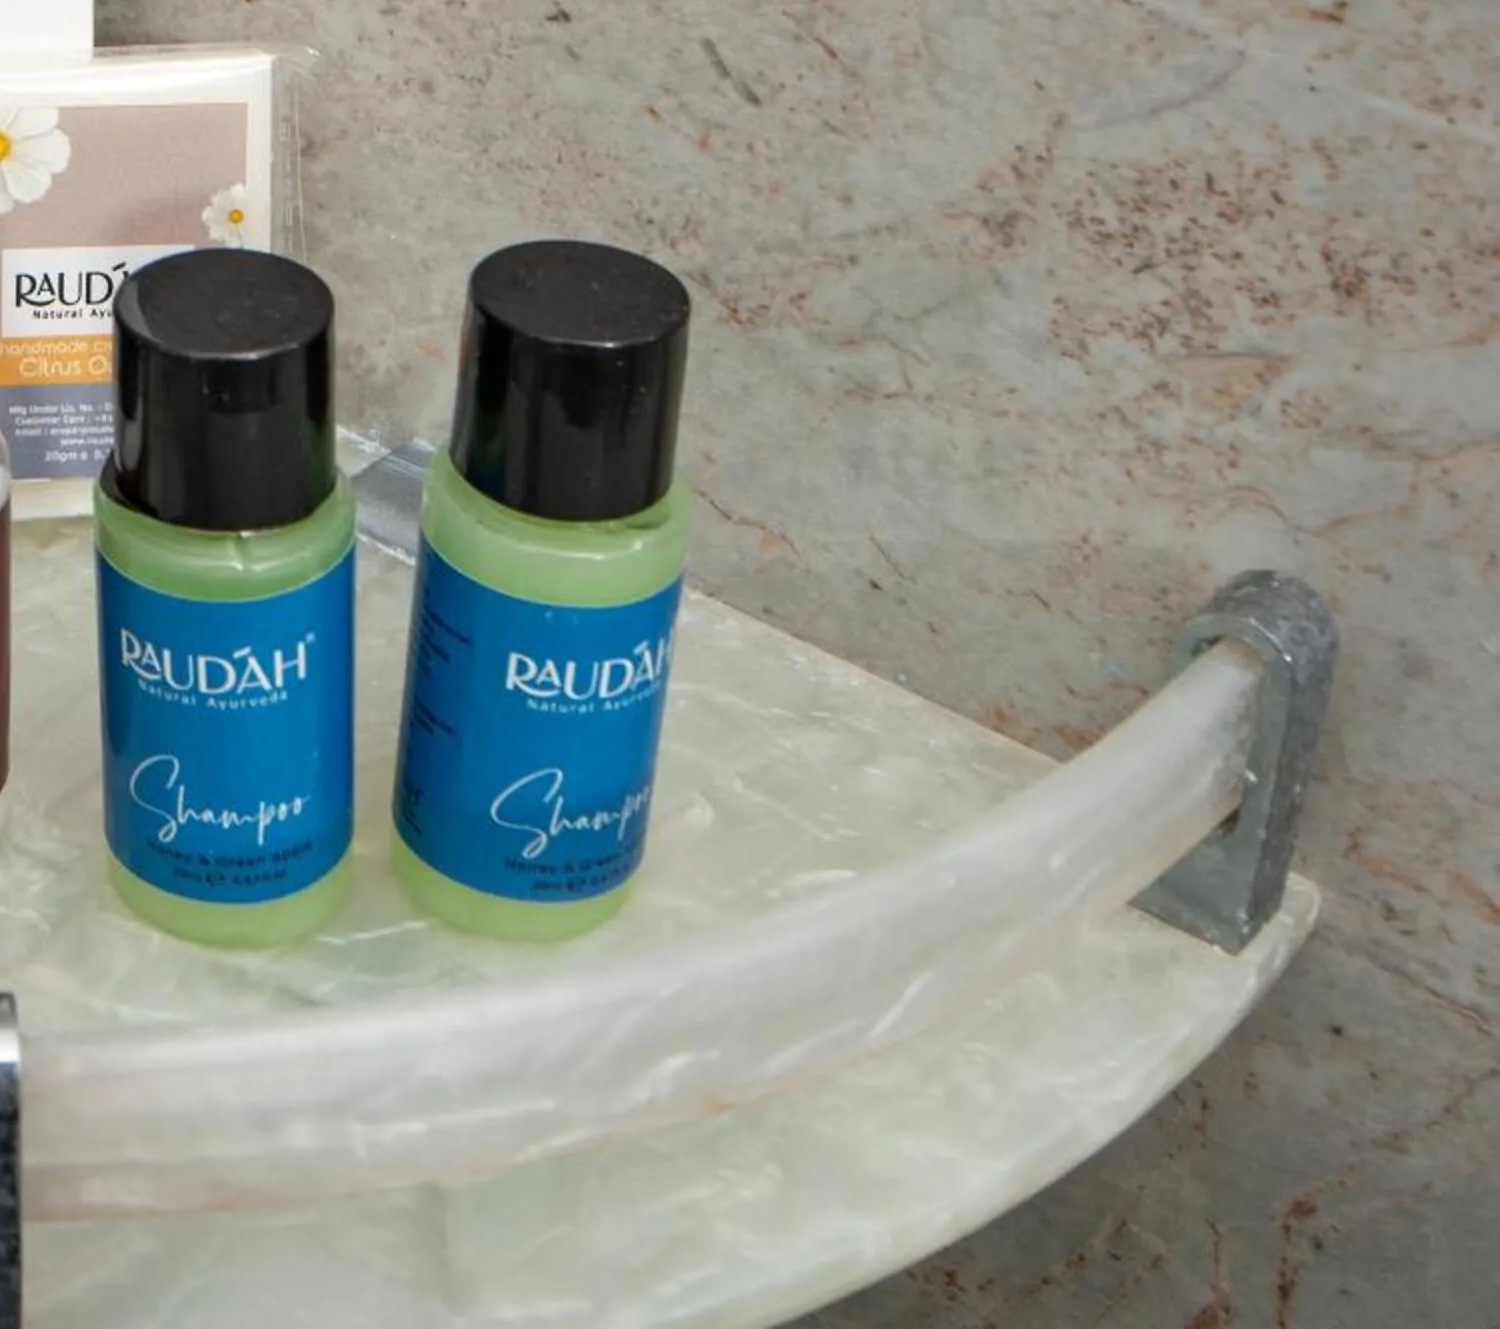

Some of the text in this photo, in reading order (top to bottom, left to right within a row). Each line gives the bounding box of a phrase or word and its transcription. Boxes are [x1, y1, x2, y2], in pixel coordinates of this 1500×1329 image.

[15, 260, 129, 307] RAUD
[32, 309, 83, 319] Natural
[19, 355, 81, 377] Citrus
[137, 678, 289, 711] Natural Ayurveda
[526, 697, 595, 713] Natural
[129, 753, 312, 847] Shampoo
